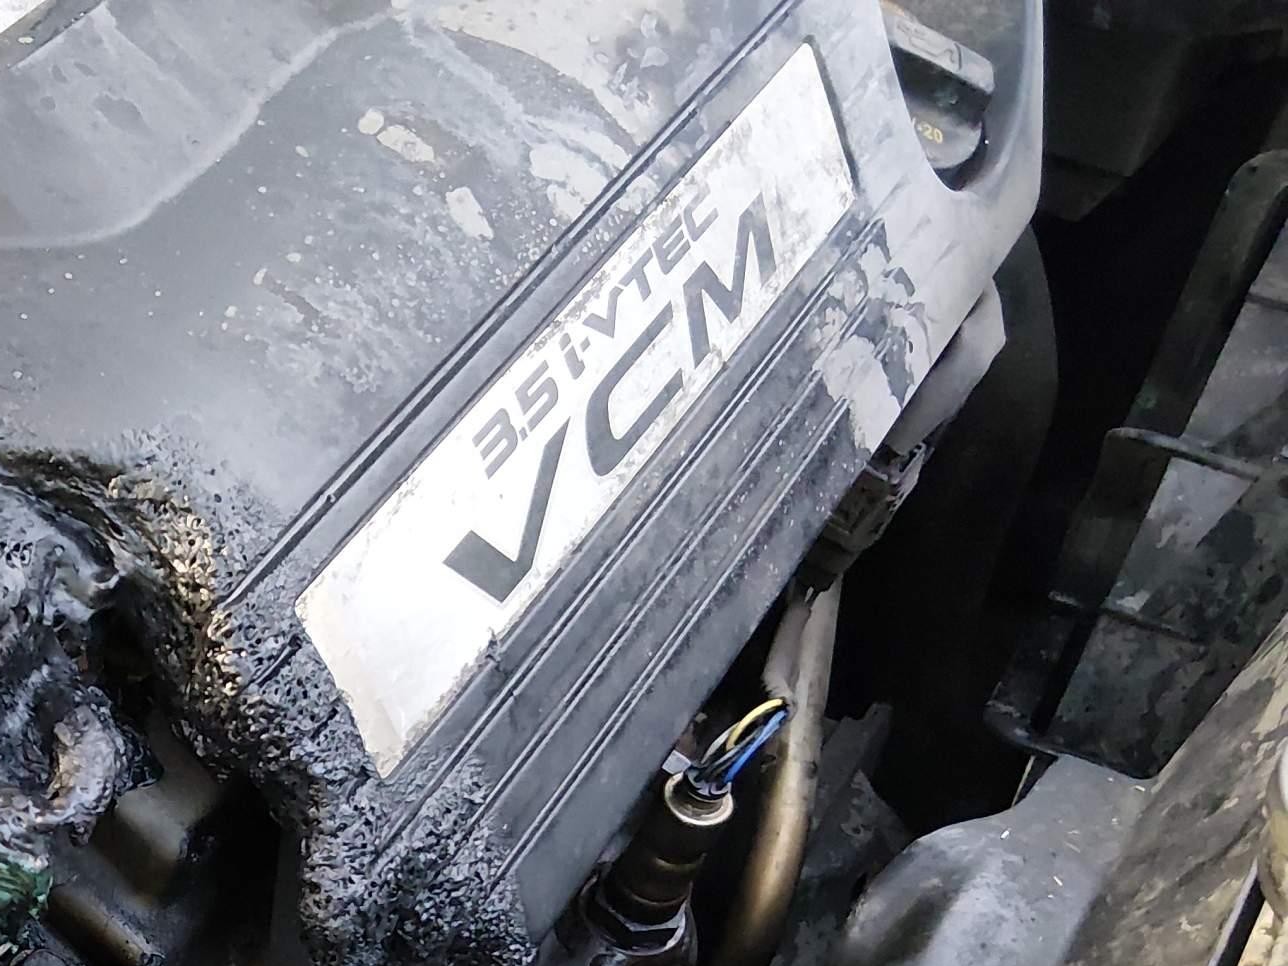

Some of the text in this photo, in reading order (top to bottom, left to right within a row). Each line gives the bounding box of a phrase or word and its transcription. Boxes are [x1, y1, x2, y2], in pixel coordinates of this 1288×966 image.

[911, 117, 944, 144] -20
[443, 190, 777, 603] VCM
[471, 182, 719, 480] 3.5 i-VTEC
